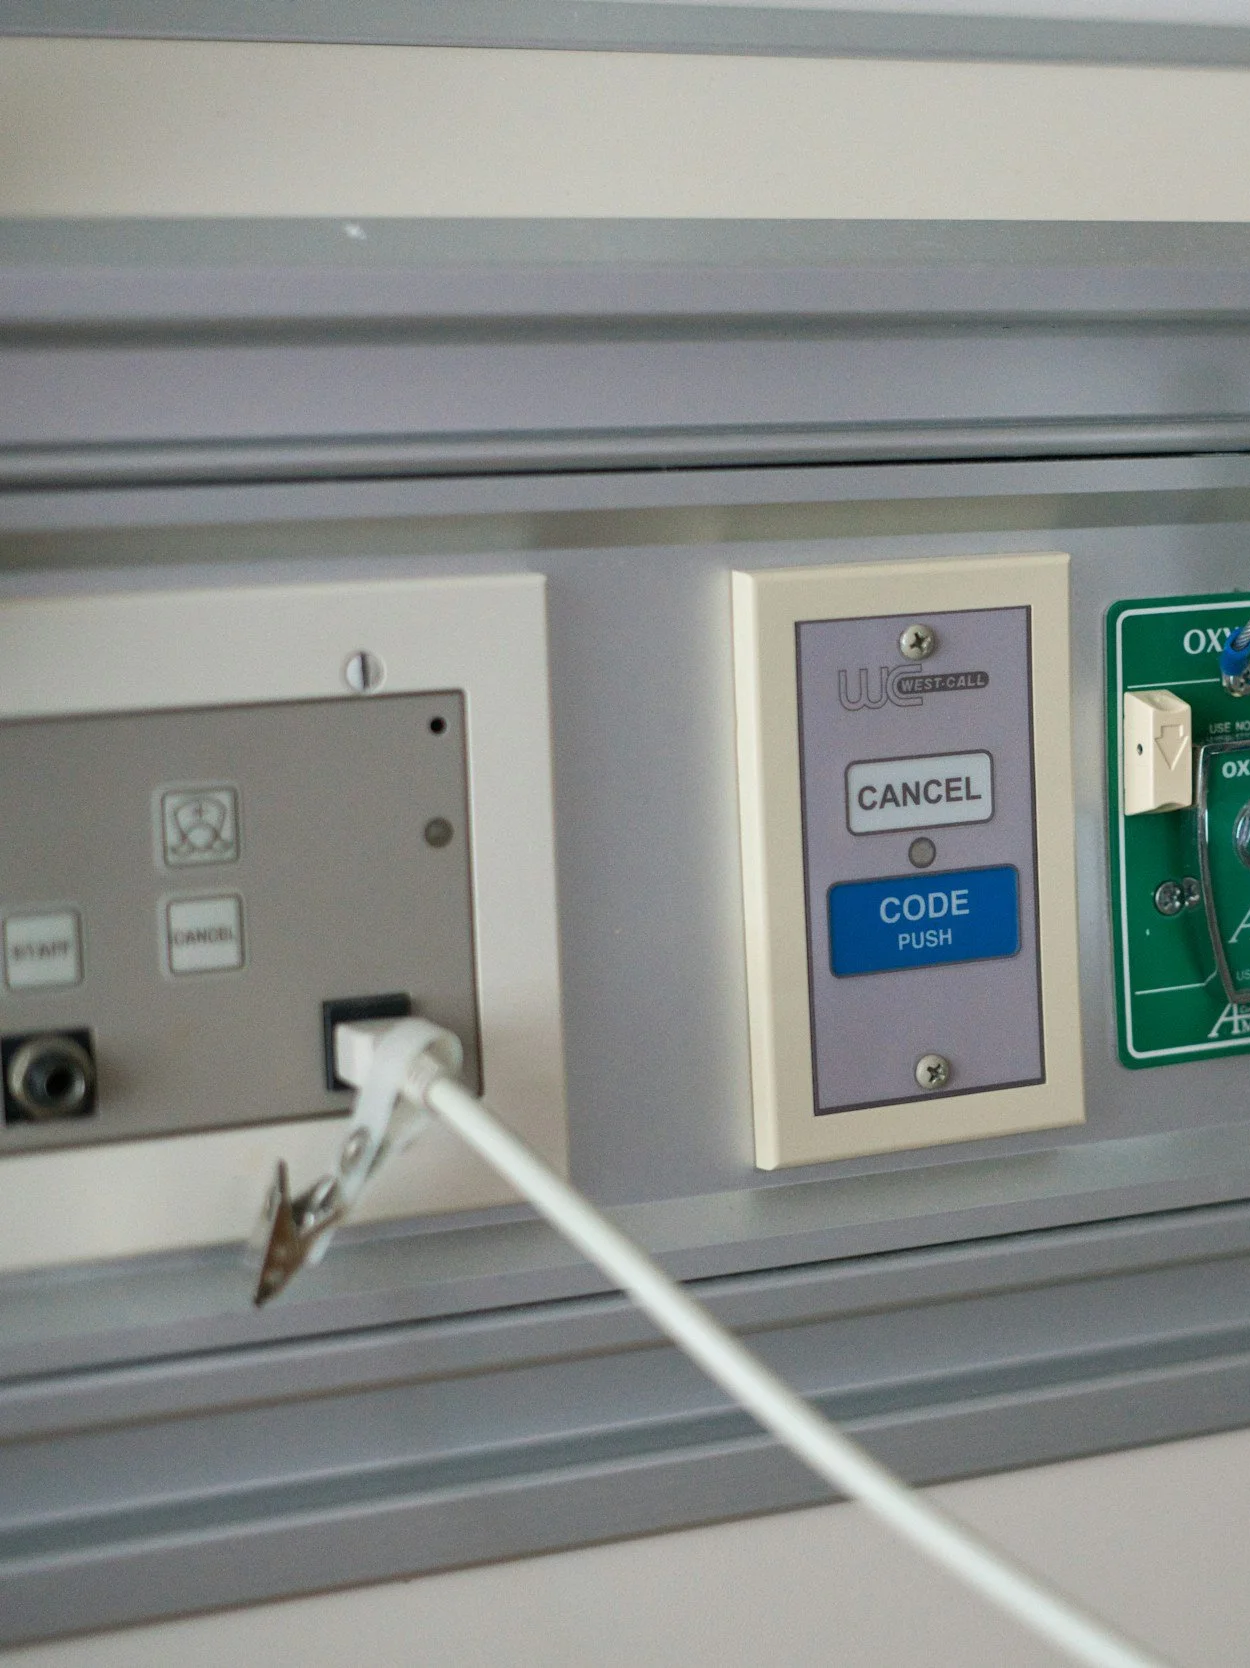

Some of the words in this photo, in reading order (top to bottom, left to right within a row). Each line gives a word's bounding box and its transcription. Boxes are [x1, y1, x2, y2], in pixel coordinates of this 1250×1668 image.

[1209, 722, 1232, 734] USE
[857, 776, 982, 811] CANCEL
[880, 889, 970, 924] CODE
[173, 925, 234, 947] CANCEL
[898, 928, 952, 951] PUSH
